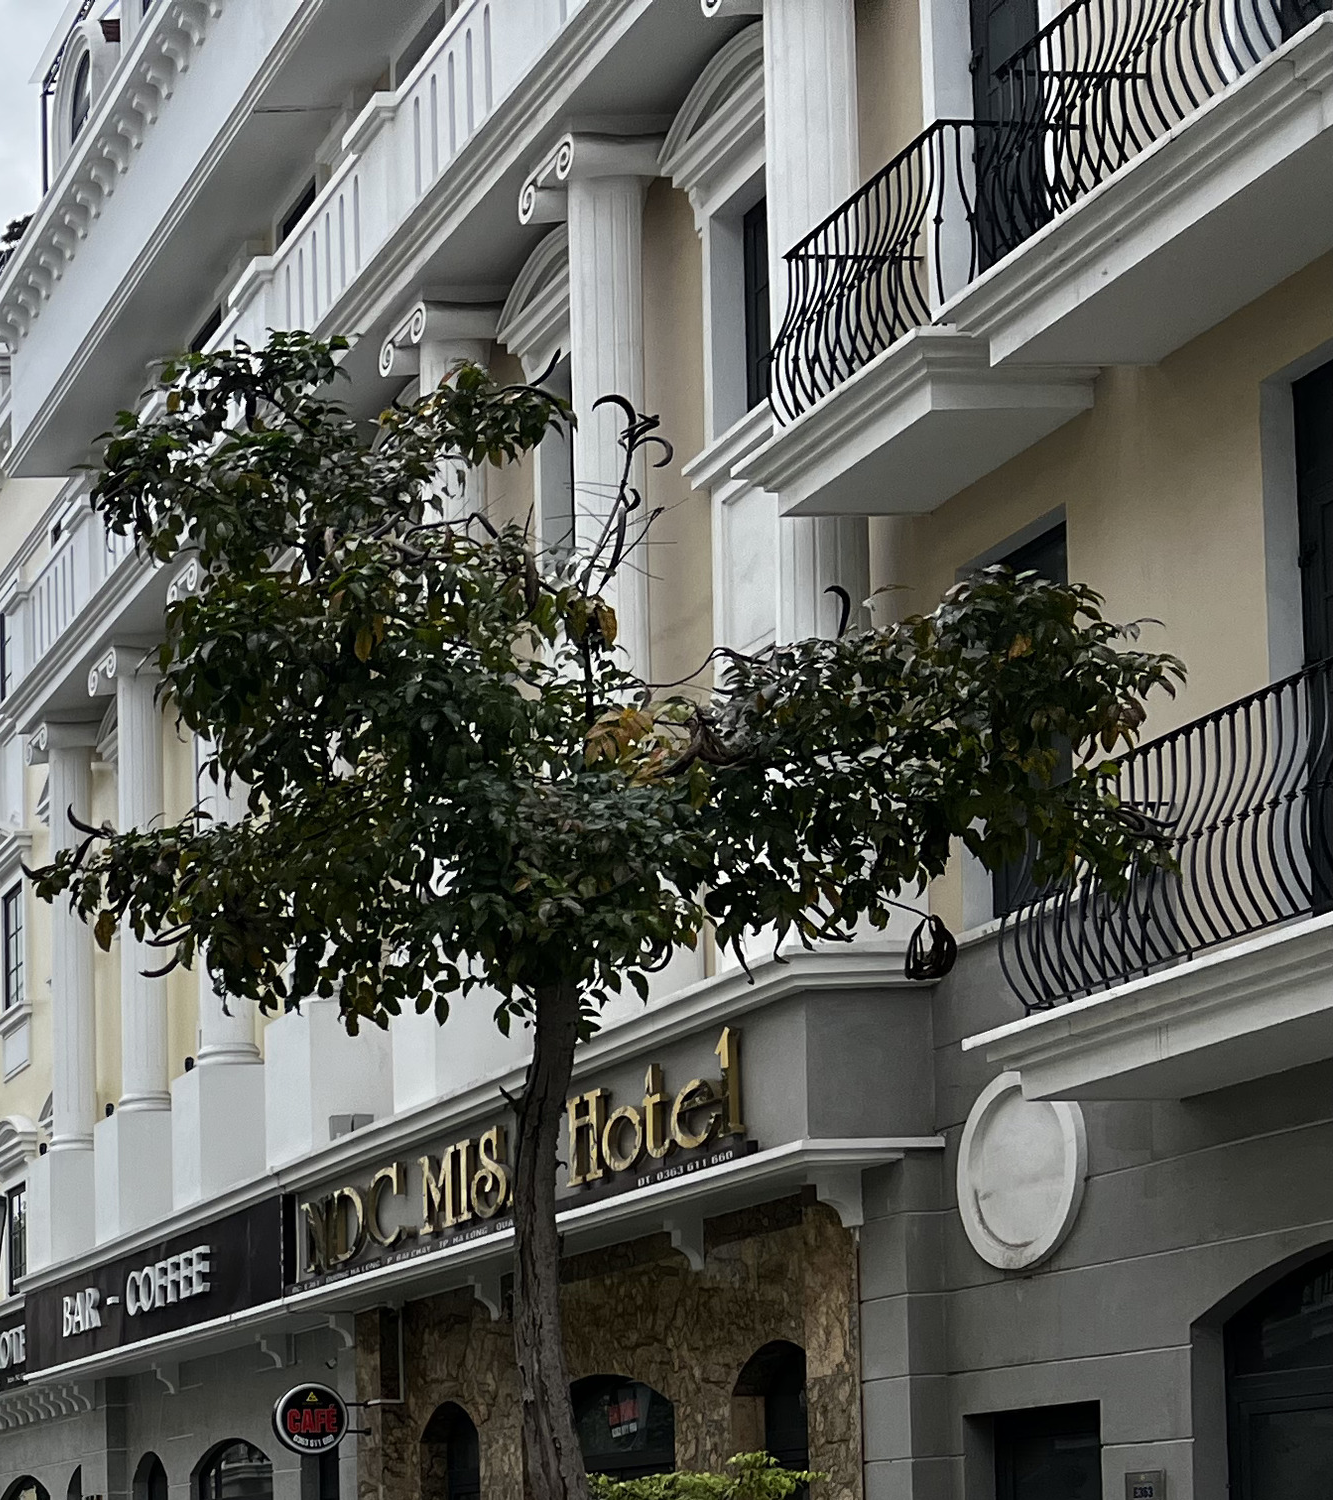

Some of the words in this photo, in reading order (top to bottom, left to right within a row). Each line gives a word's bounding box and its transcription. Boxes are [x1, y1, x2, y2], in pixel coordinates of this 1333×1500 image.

[300, 1161, 406, 1274] NDC
[418, 1124, 513, 1236] MIS
[566, 1026, 746, 1188] Hotel
[656, 1165, 684, 1181] 0363
[686, 1158, 707, 1172] 611
[711, 1150, 734, 1164] 660
[62, 1287, 102, 1338] BAR
[125, 1244, 211, 1317] COFFEE
[287, 1404, 337, 1433] CAFÉ
